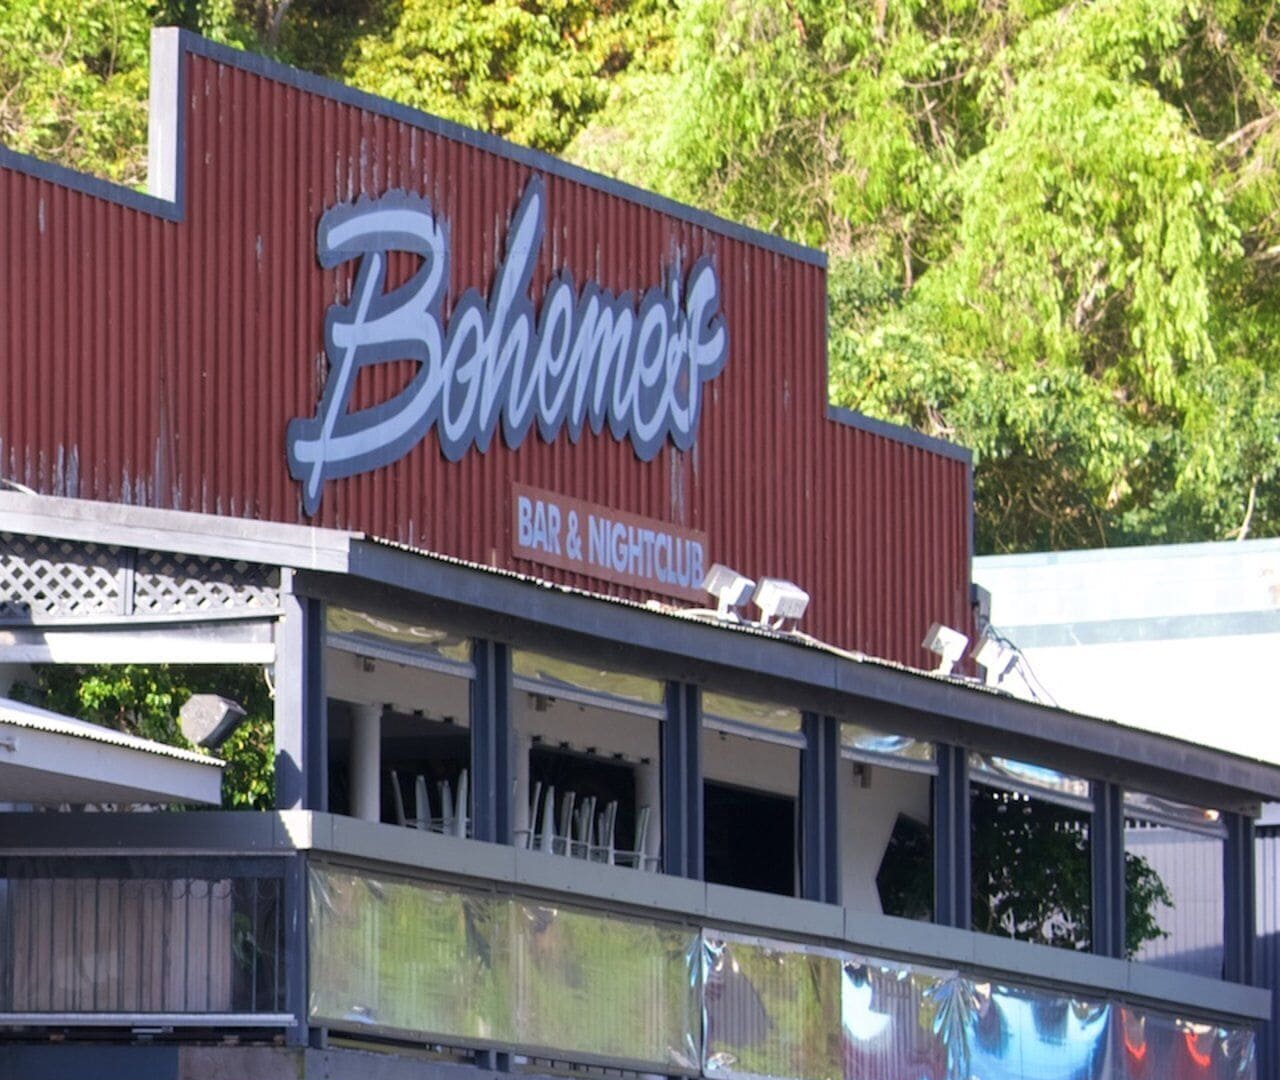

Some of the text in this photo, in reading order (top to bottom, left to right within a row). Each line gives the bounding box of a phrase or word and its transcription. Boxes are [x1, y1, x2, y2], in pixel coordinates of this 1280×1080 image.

[518, 496, 705, 589] BAR & NIGHTCLUB
